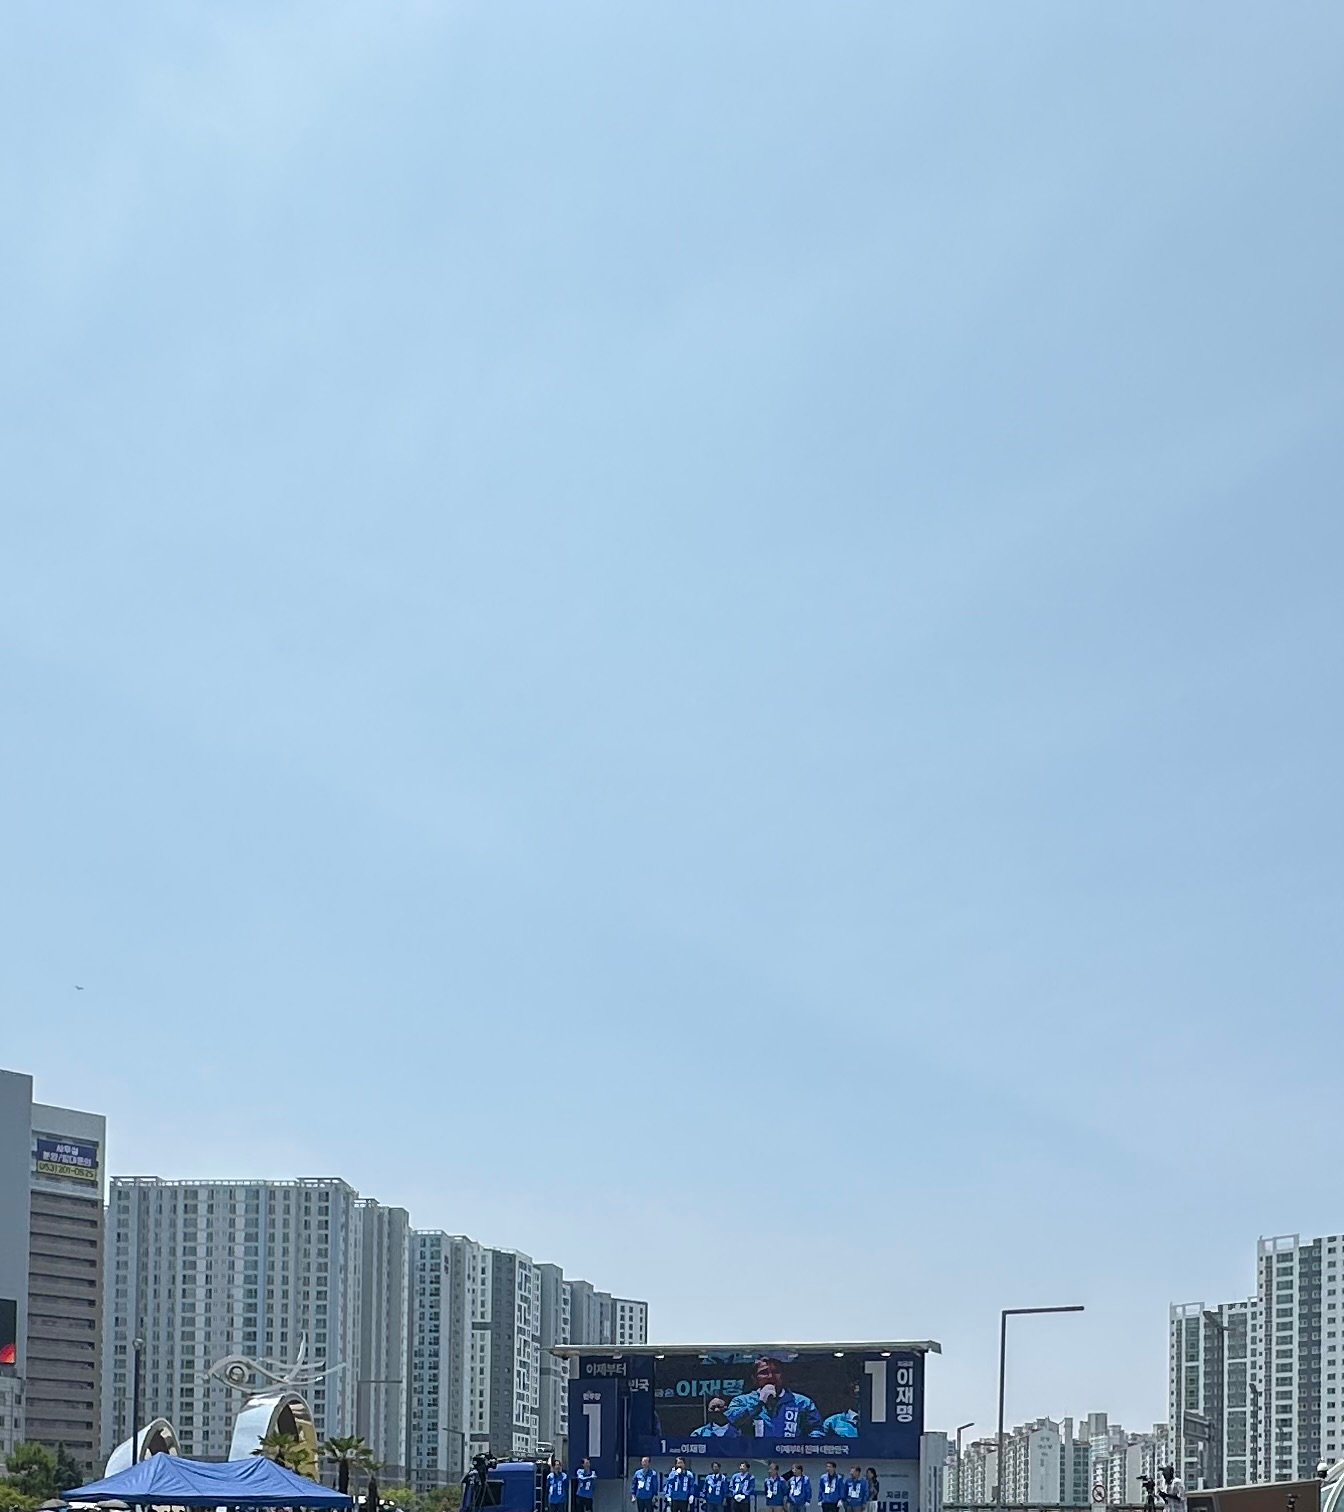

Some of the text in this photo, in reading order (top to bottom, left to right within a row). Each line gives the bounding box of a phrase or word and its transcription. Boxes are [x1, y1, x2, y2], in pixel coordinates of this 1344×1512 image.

[586, 1363, 627, 1376] 이제부터
[676, 1379, 744, 1397] 이재명
[864, 1361, 887, 1422] 1
[896, 1368, 914, 1422] 이재명
[583, 1403, 601, 1457] 1
[886, 1490, 909, 1499] 지금은
